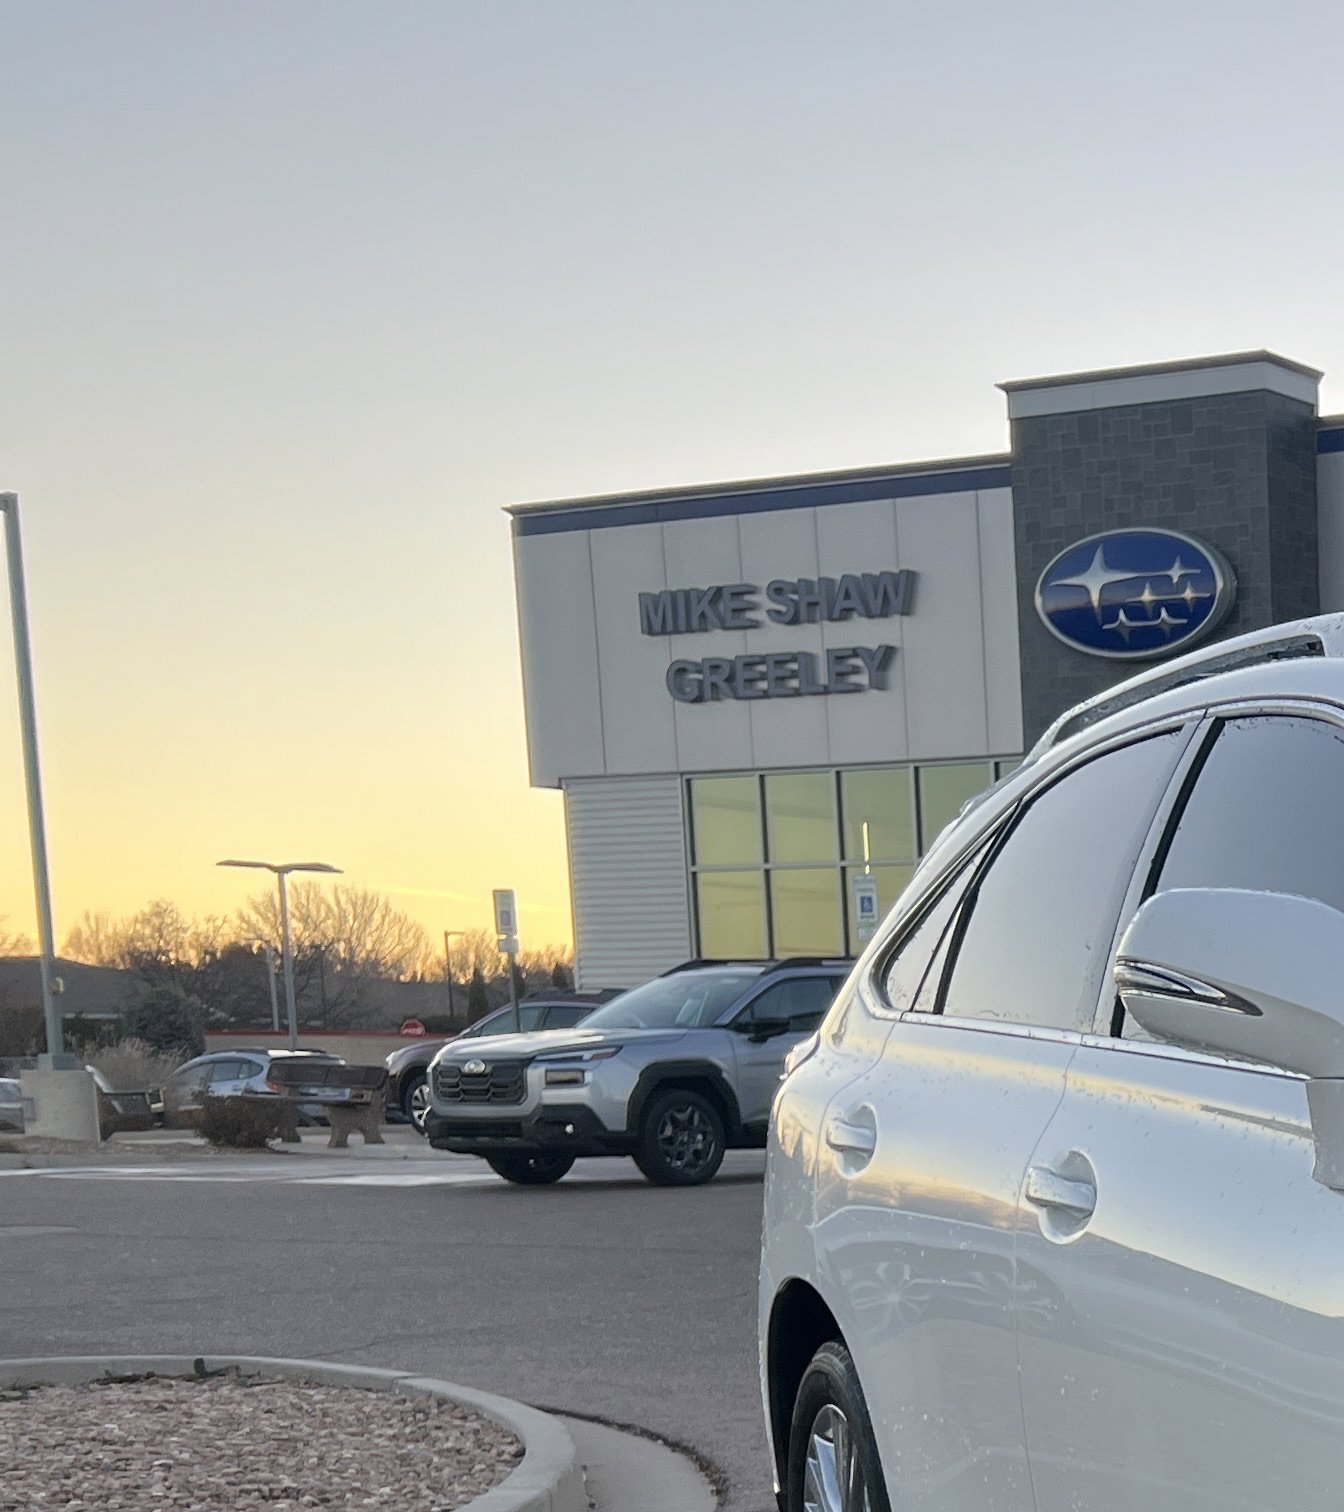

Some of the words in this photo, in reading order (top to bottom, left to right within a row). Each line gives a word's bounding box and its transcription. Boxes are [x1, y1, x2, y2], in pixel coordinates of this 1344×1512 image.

[638, 583, 761, 636] MIKE
[765, 569, 919, 626] SHAW
[666, 644, 897, 704] GREELEY
